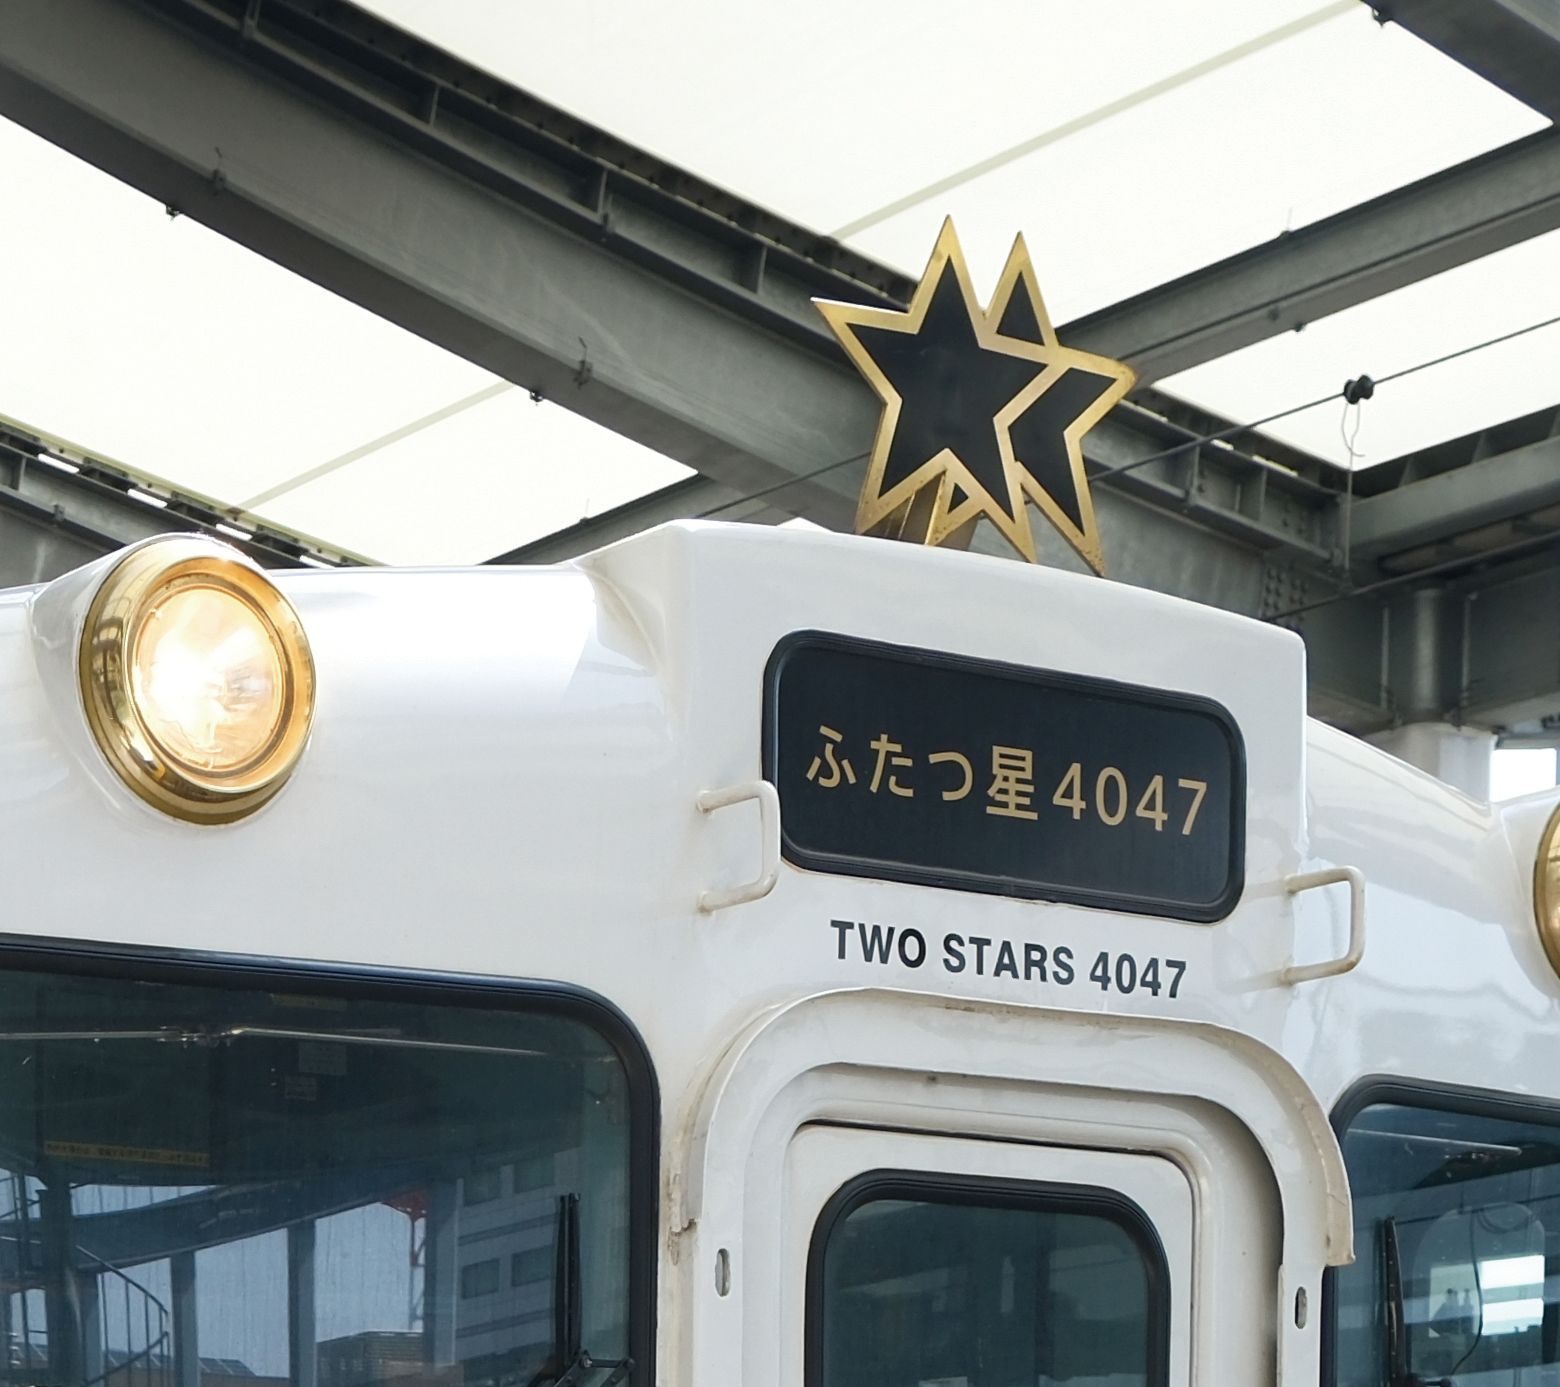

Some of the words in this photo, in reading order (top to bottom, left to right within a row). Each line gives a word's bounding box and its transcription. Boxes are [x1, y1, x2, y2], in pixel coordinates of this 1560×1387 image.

[807, 725, 1208, 836] ふたつ星4047
[830, 920, 927, 969] TWO
[942, 932, 1075, 986] STARS
[1090, 951, 1188, 999] 4047
